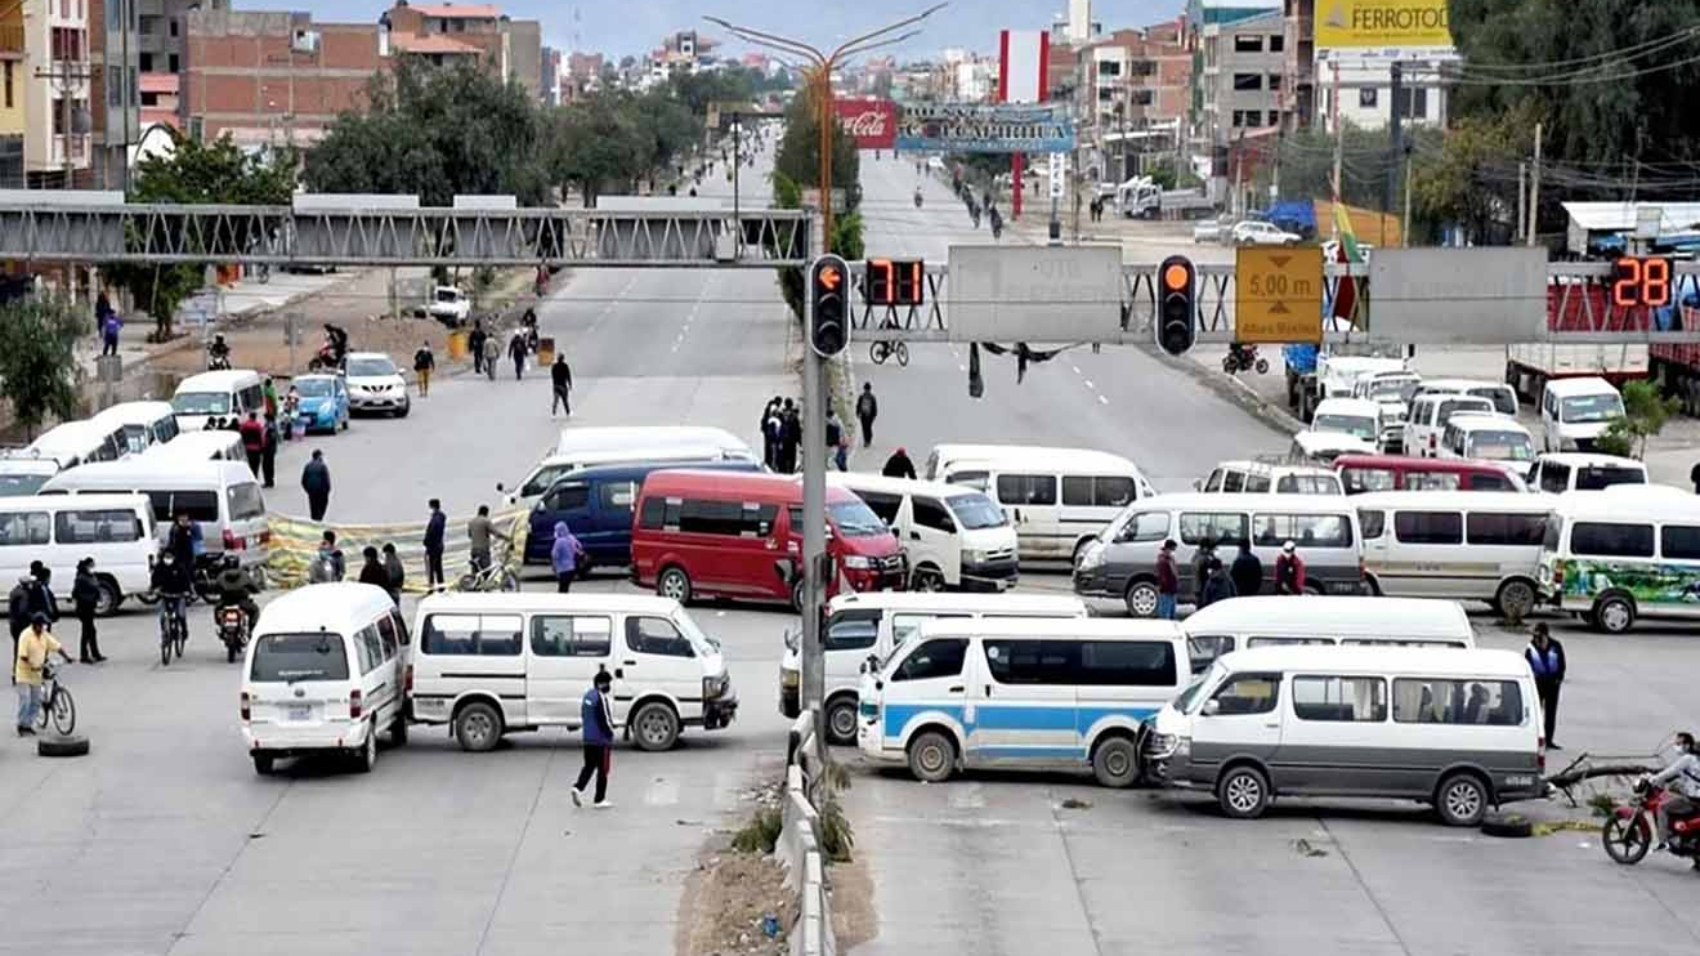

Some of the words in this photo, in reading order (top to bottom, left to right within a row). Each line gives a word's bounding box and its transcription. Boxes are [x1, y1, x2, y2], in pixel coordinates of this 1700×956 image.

[905, 123, 1066, 138] CLCAPIRHUA
[870, 258, 920, 304] 71
[1293, 280, 1311, 296] m
[1614, 257, 1669, 307] 28
